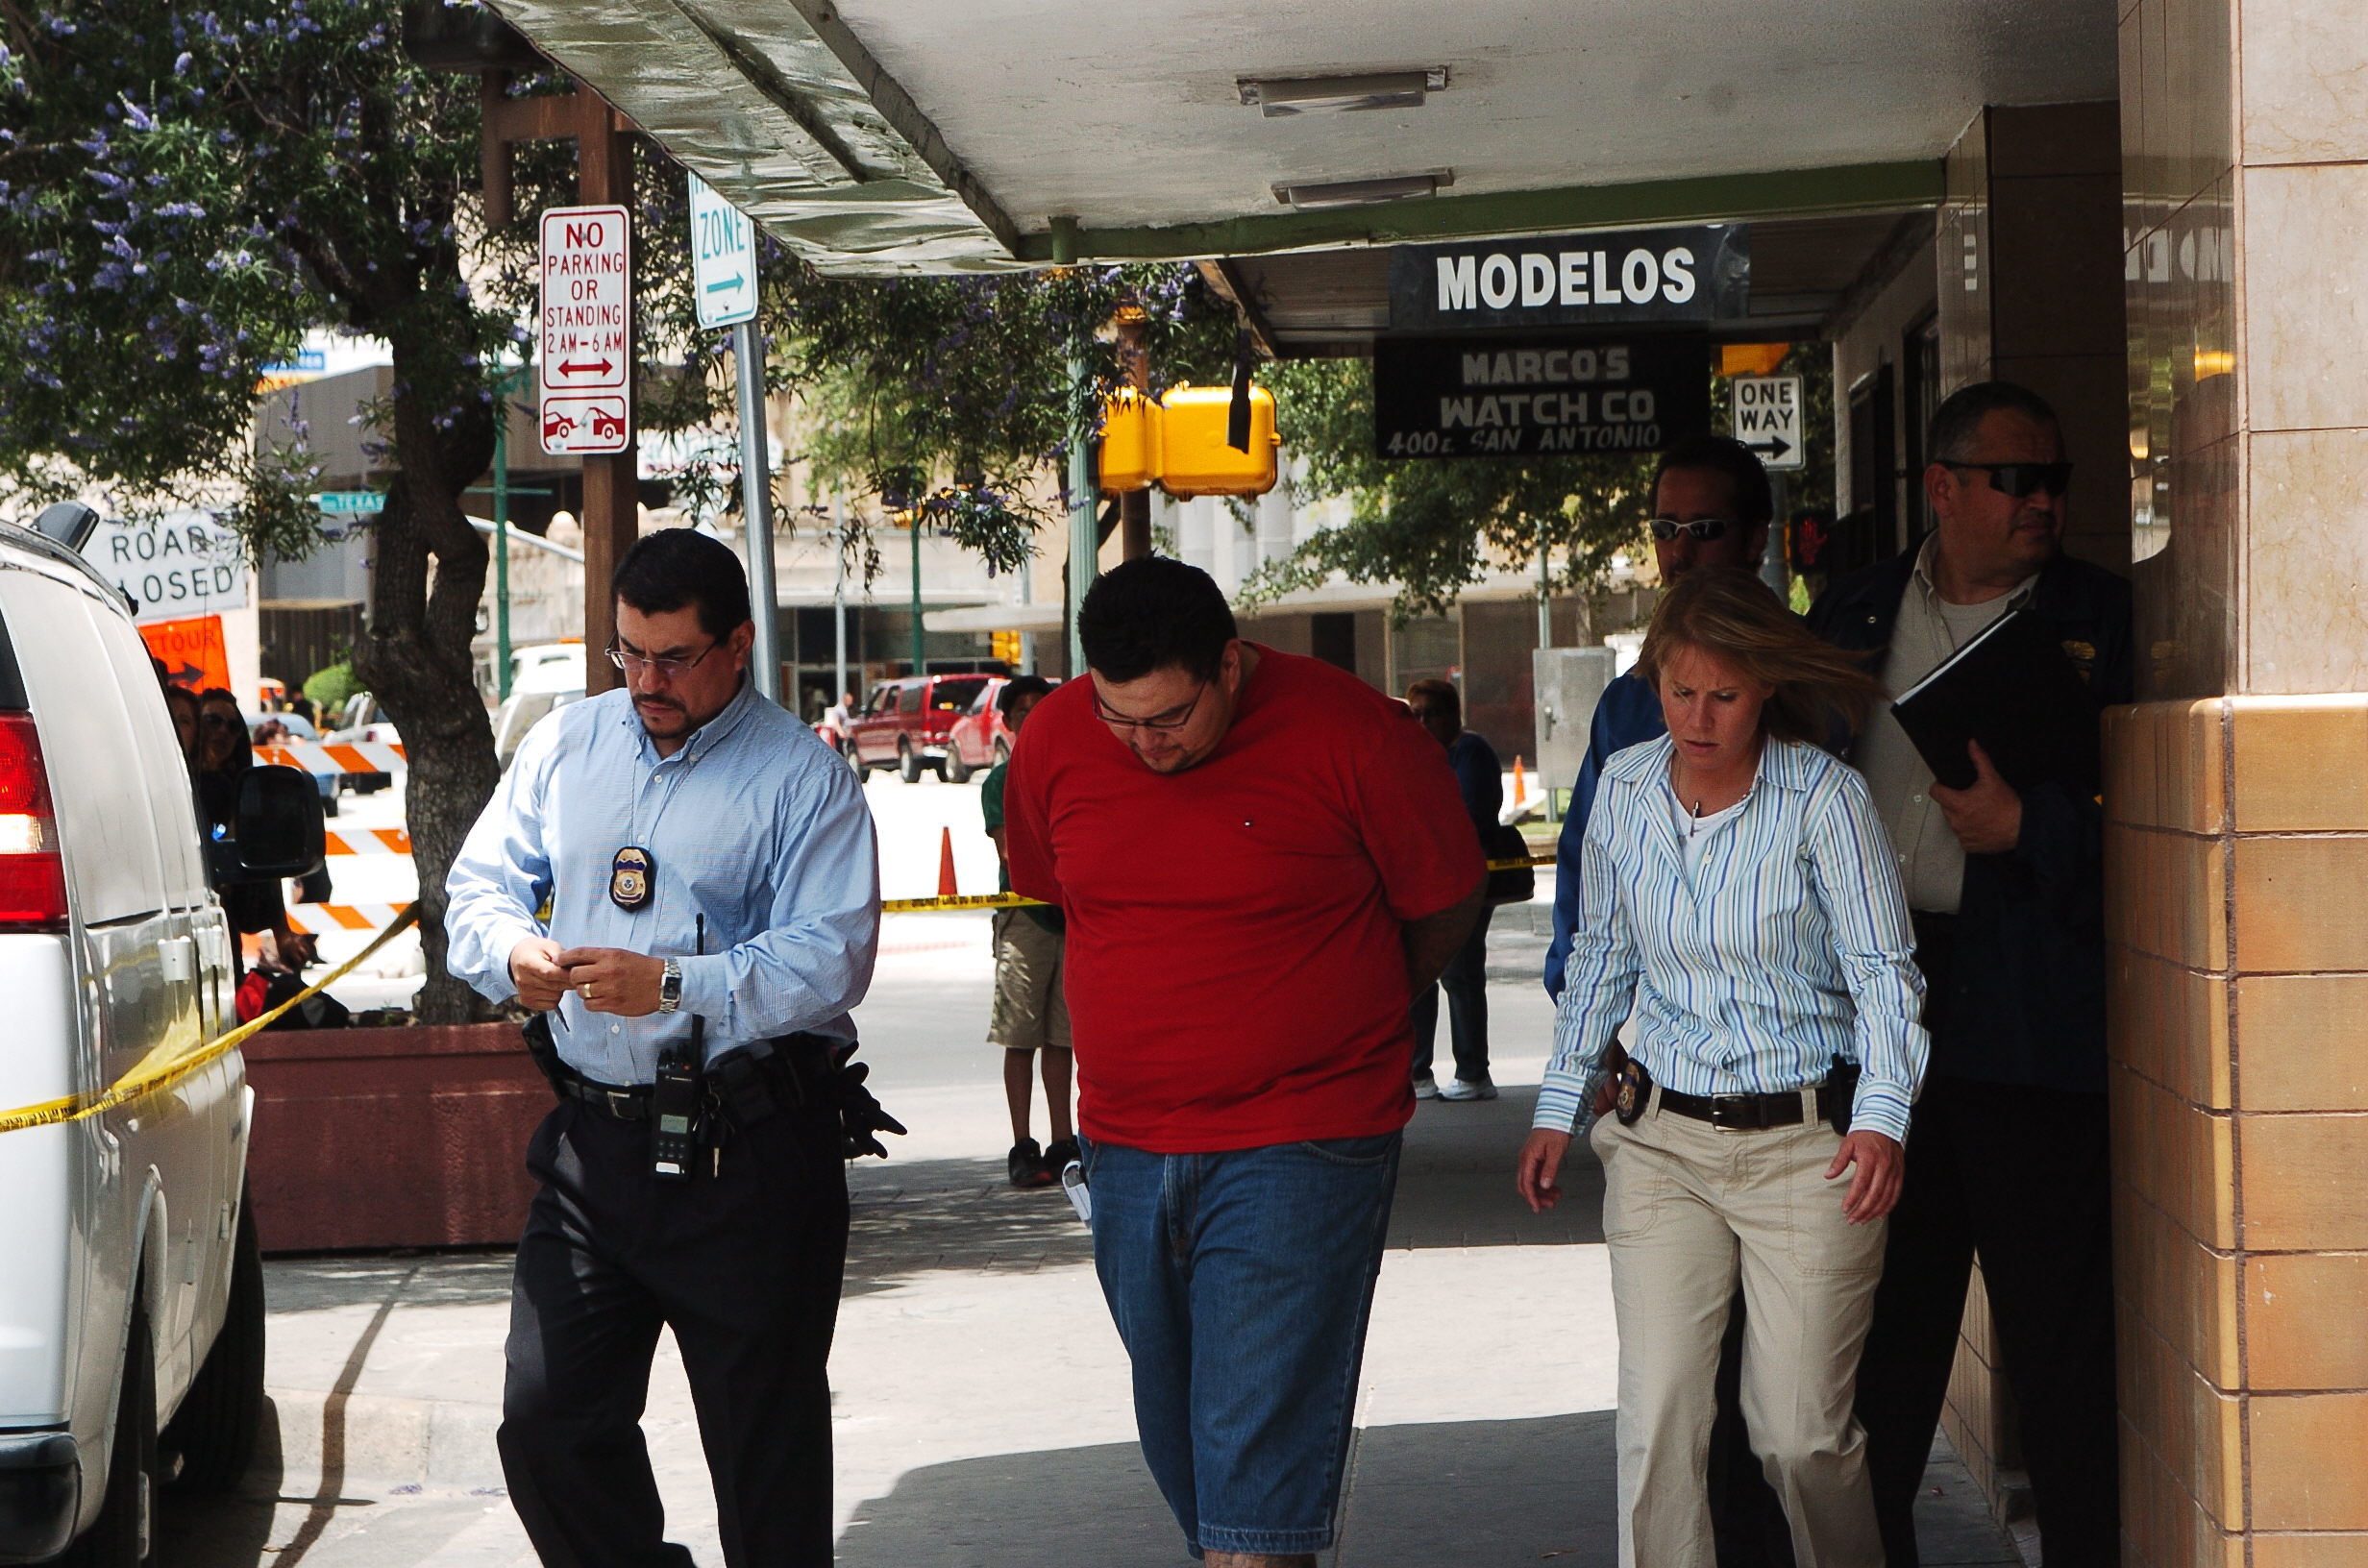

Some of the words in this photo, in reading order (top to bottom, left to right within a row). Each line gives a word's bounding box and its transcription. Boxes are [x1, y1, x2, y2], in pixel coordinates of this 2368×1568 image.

[566, 222, 604, 249] NO
[700, 205, 745, 259] ZONE
[548, 252, 623, 276] PARKING
[571, 279, 598, 301] OR
[1437, 247, 1695, 310] MODELOS
[547, 304, 621, 328] STANDING
[1462, 347, 1630, 384] MARCO'S
[1740, 381, 1793, 405] ONE
[1442, 393, 1589, 429] WATCH
[1602, 390, 1655, 422] CO
[1740, 408, 1794, 431] WAY
[1471, 429, 1521, 453] SAN
[1540, 425, 1661, 451] ANTONIO
